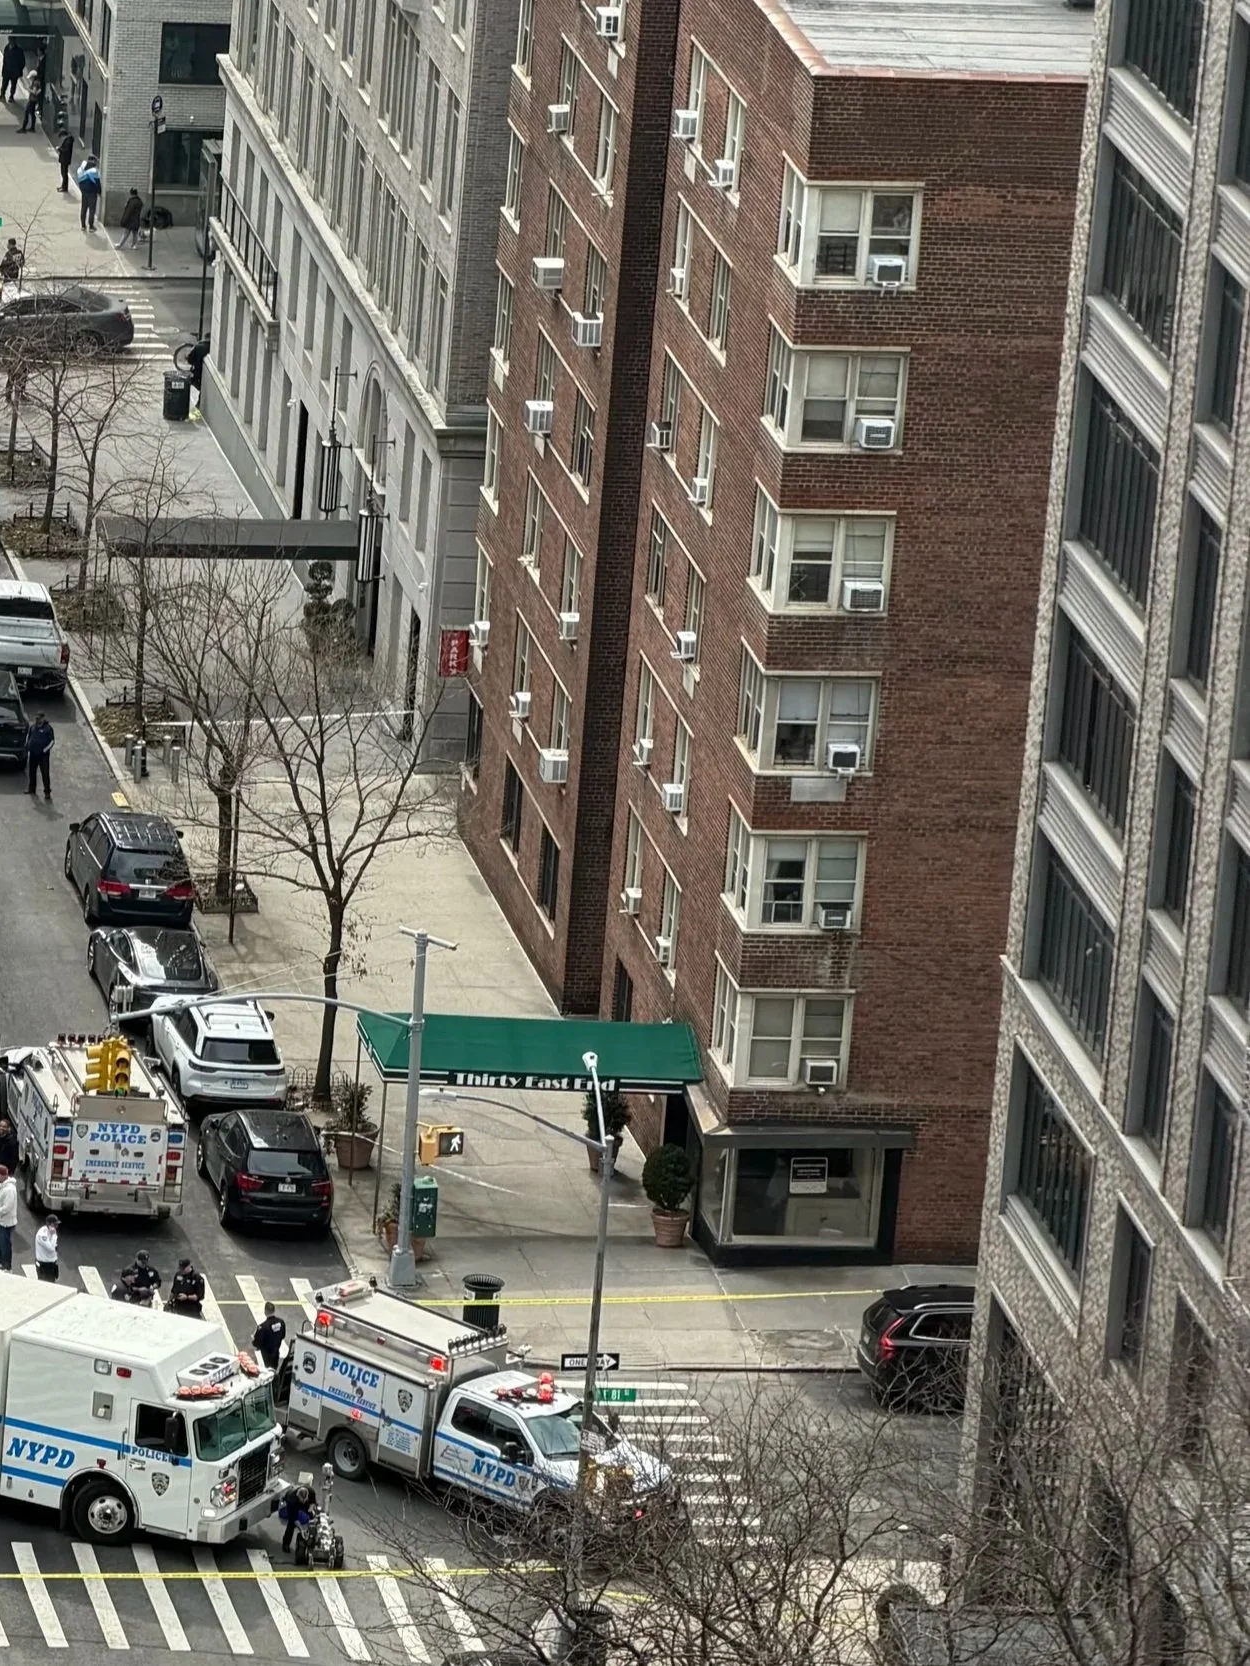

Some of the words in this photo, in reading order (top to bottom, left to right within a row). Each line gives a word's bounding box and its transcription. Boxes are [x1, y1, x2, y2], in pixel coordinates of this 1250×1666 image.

[453, 1072, 522, 1088] Thirty
[524, 1075, 570, 1090] East
[97, 1123, 141, 1134] NYPD
[89, 1132, 147, 1145] POLICE
[568, 1358, 588, 1367] ONE
[329, 1356, 380, 1389] POLICE
[611, 1389, 621, 1401] 81
[6, 1436, 76, 1469] NYPD
[131, 1445, 171, 1464] POLICE
[471, 1457, 517, 1488] NYPD
